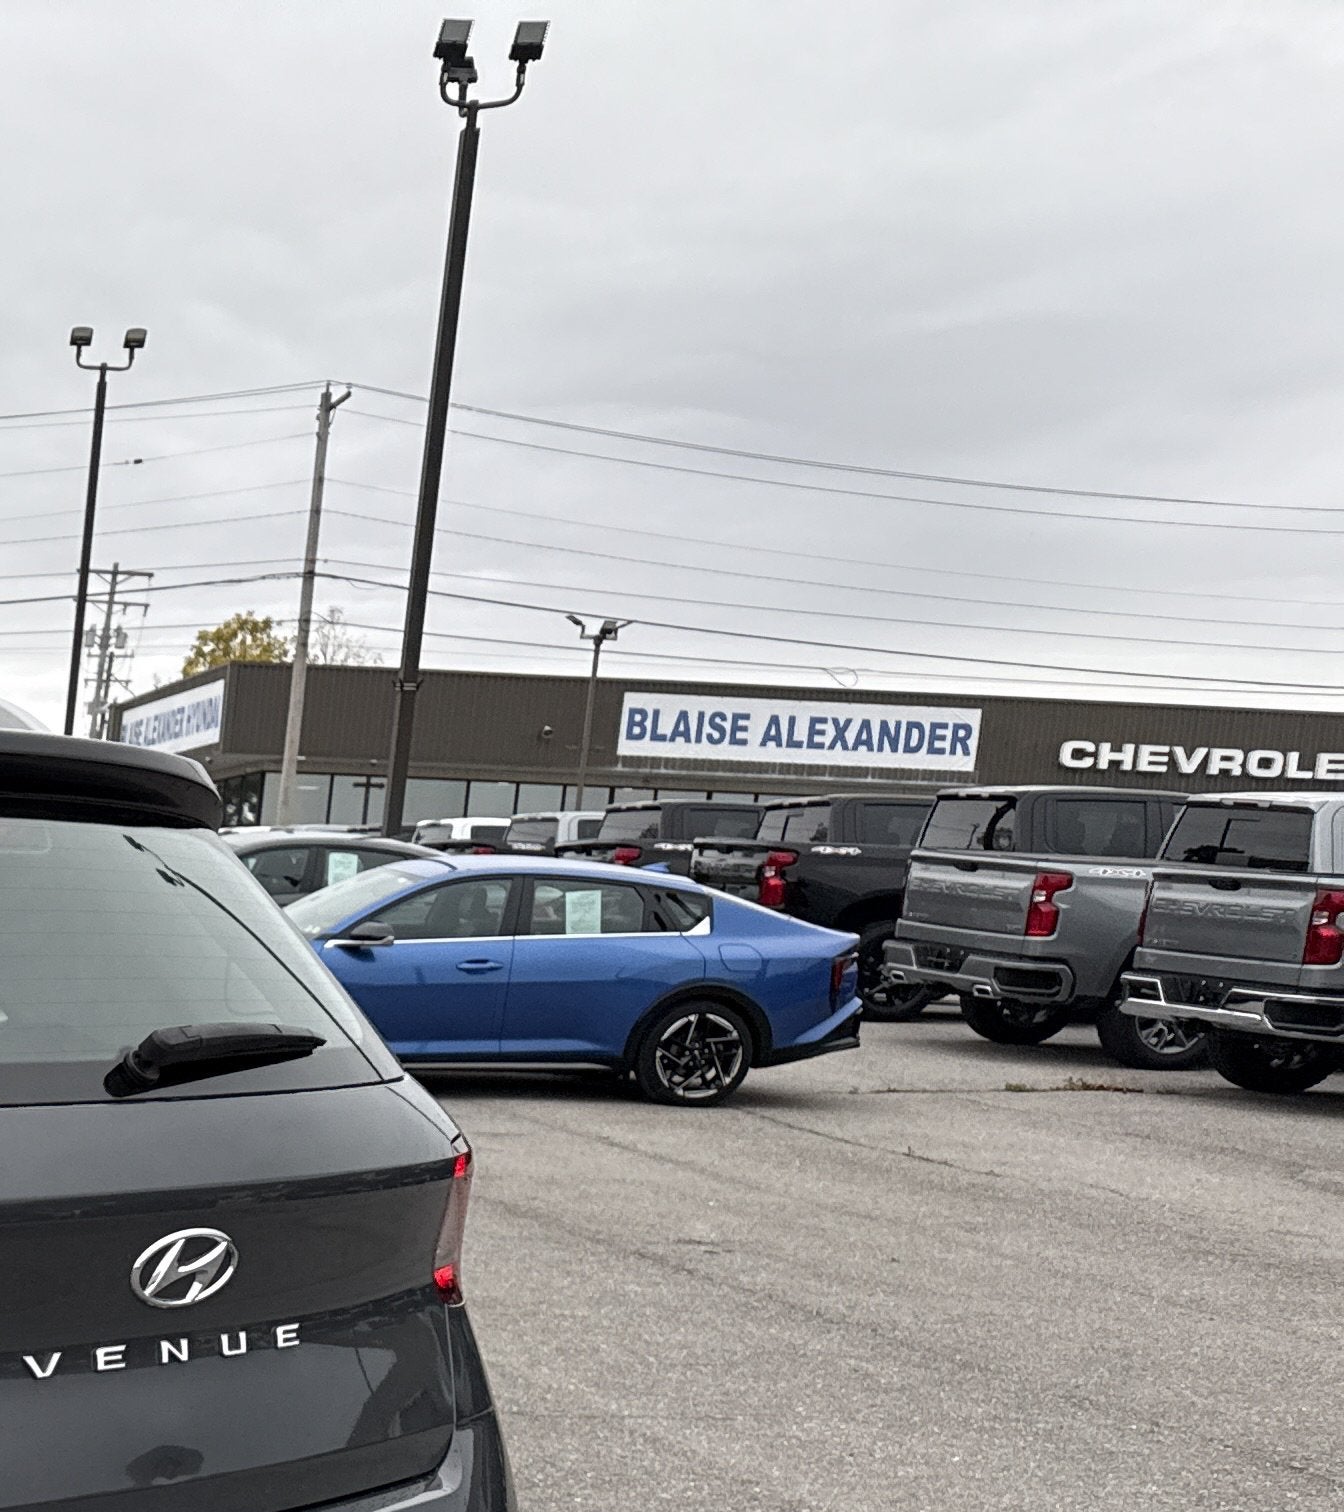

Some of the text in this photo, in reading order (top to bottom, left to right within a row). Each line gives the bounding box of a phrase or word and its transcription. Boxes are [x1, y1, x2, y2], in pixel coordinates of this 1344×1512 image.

[625, 706, 974, 757] BLAISE ALEXANDER
[1058, 739, 1344, 781] CHEVROLE
[22, 1322, 301, 1379] VENUE
